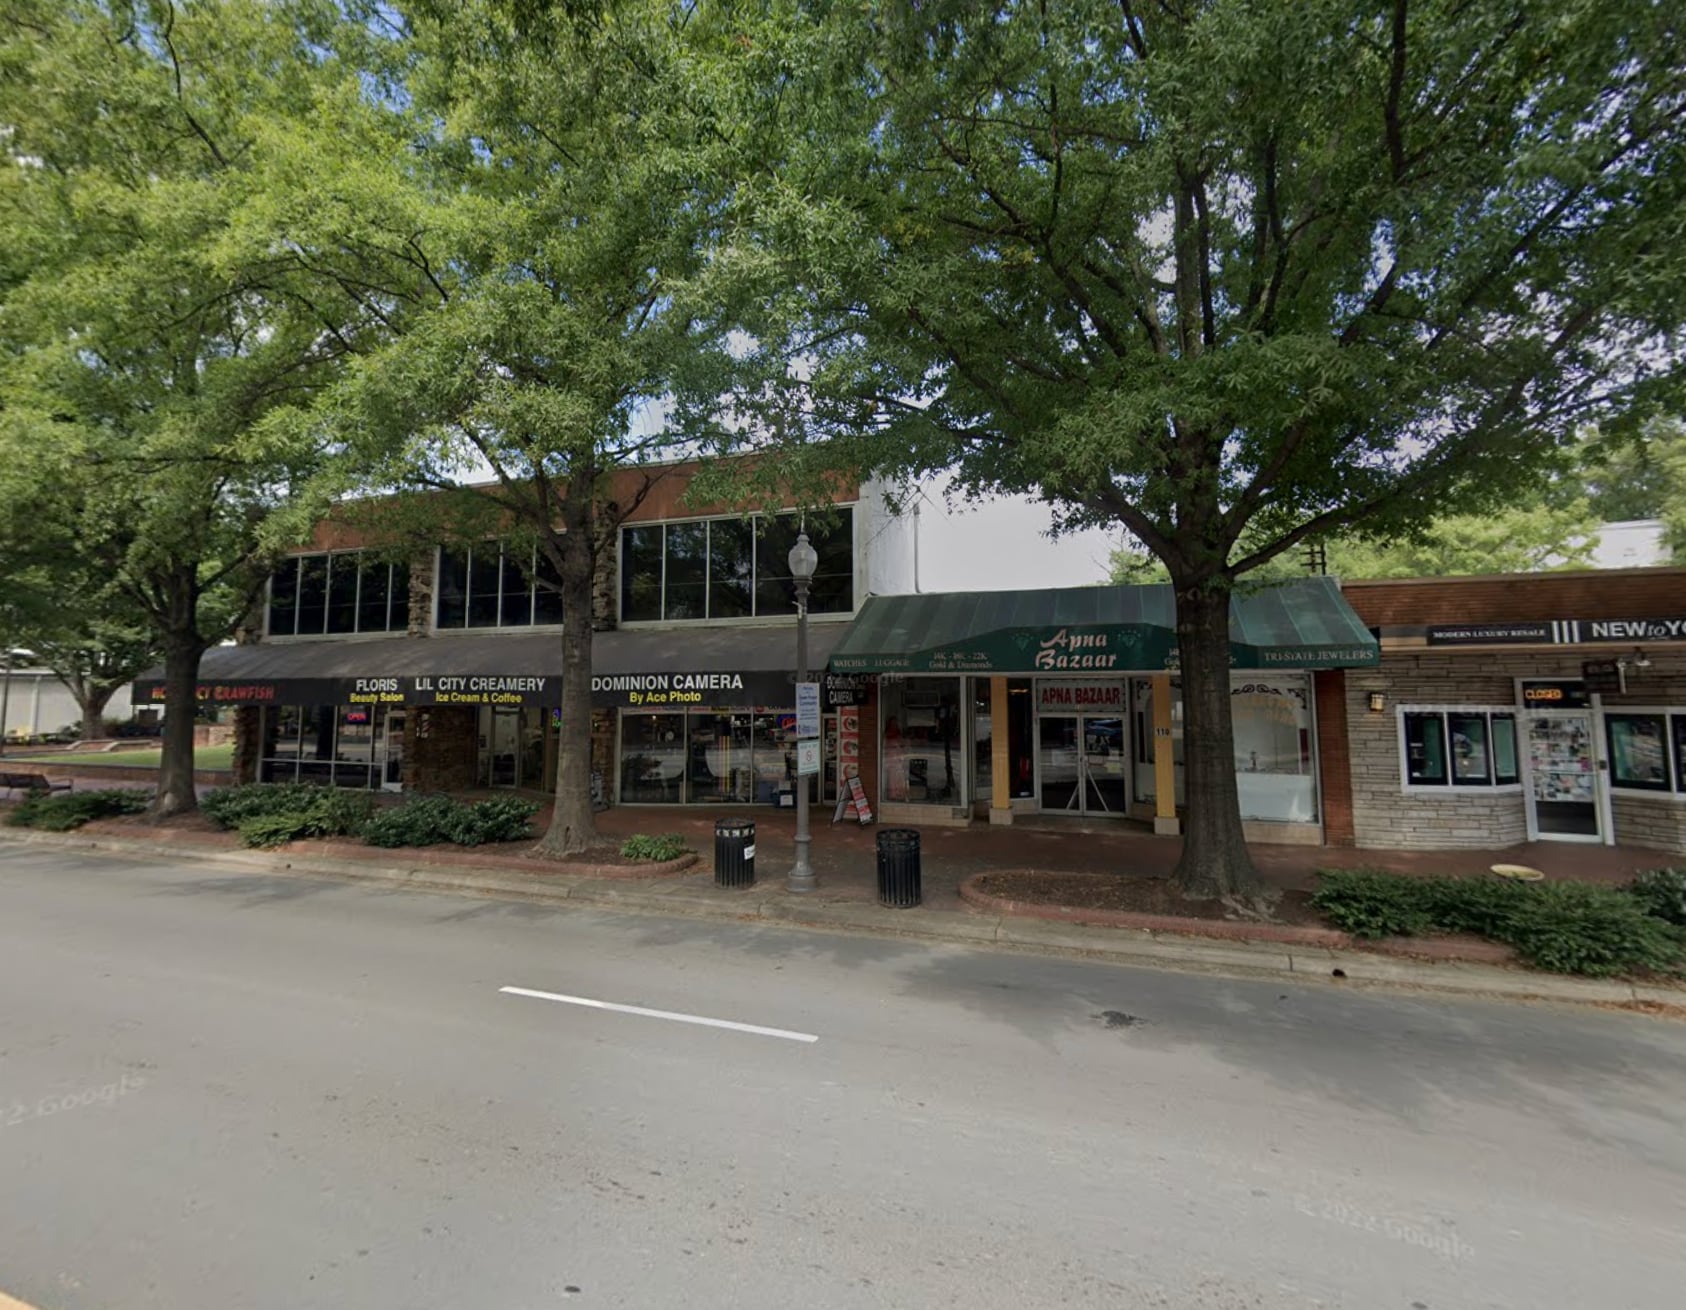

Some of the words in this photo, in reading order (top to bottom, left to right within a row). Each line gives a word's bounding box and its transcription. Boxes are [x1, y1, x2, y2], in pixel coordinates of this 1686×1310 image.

[1433, 631, 1472, 639] MODERN
[1473, 630, 1510, 638] LUXURY
[1511, 629, 1545, 637] RESALE
[1592, 621, 1647, 638] NEW
[1040, 628, 1107, 652] Apna
[1035, 648, 1117, 670] Bazaar
[1317, 650, 1374, 660] JEWELERS
[833, 659, 867, 668] WATCHES
[874, 659, 910, 667] LUGGAGE
[929, 661, 946, 669] Gold
[958, 661, 993, 669] Diamonds
[356, 678, 398, 692] FLORIS
[415, 677, 434, 691] LIL
[438, 677, 467, 691] CITY
[470, 678, 546, 692] CREAMERY
[592, 675, 668, 691] DOMINION
[673, 674, 743, 690] CAMERA
[214, 686, 275, 700] CRAWFISH
[350, 693, 378, 704] Beauty
[380, 692, 405, 702] Salon
[435, 691, 449, 702] Ice
[451, 692, 480, 703] Cream
[482, 692, 489, 703] &
[491, 692, 522, 703] Coffee
[630, 692, 643, 705] By
[646, 692, 666, 703] Ace
[670, 691, 701, 702] Photo
[828, 691, 854, 705] CAMERA
[1042, 687, 1072, 705] APNA
[1075, 687, 1121, 705] BAZAAR
[1156, 728, 1170, 737] 110
